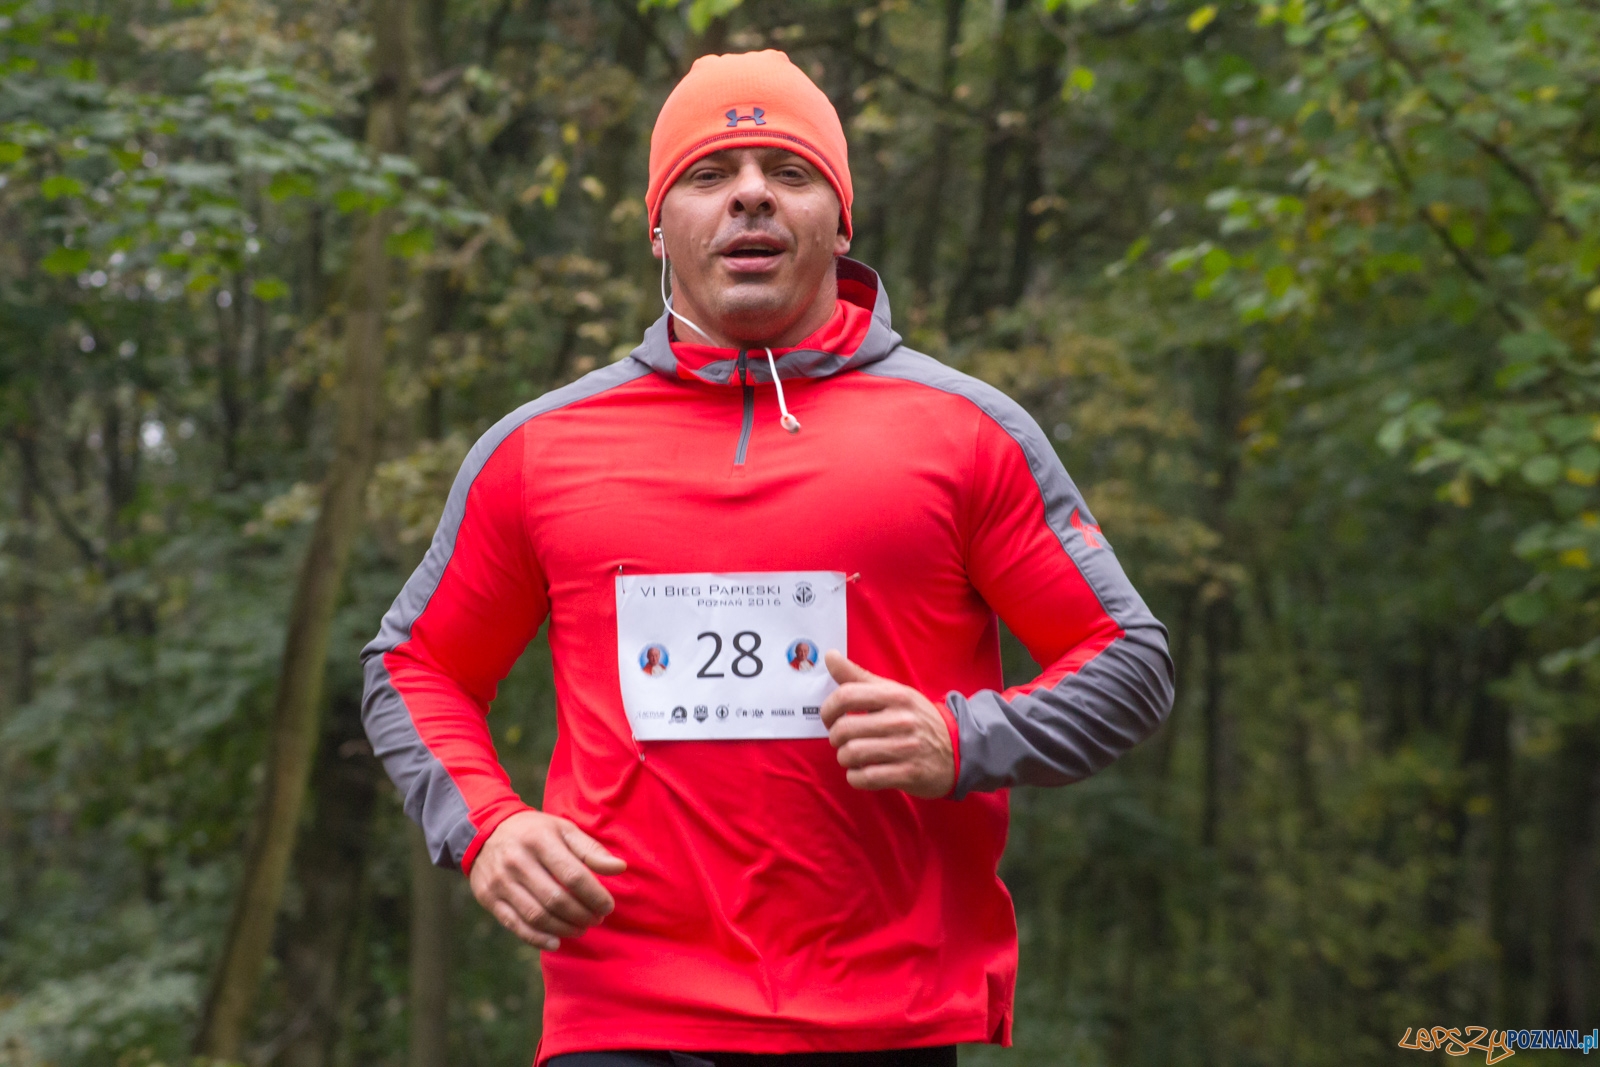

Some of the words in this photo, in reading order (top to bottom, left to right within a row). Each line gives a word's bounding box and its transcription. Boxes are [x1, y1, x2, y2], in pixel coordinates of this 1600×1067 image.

[640, 585, 656, 598] VI
[664, 585, 701, 597] BIEG
[709, 584, 781, 596] PAPIESKI
[748, 598, 781, 607] 2016
[696, 630, 764, 679] 28
